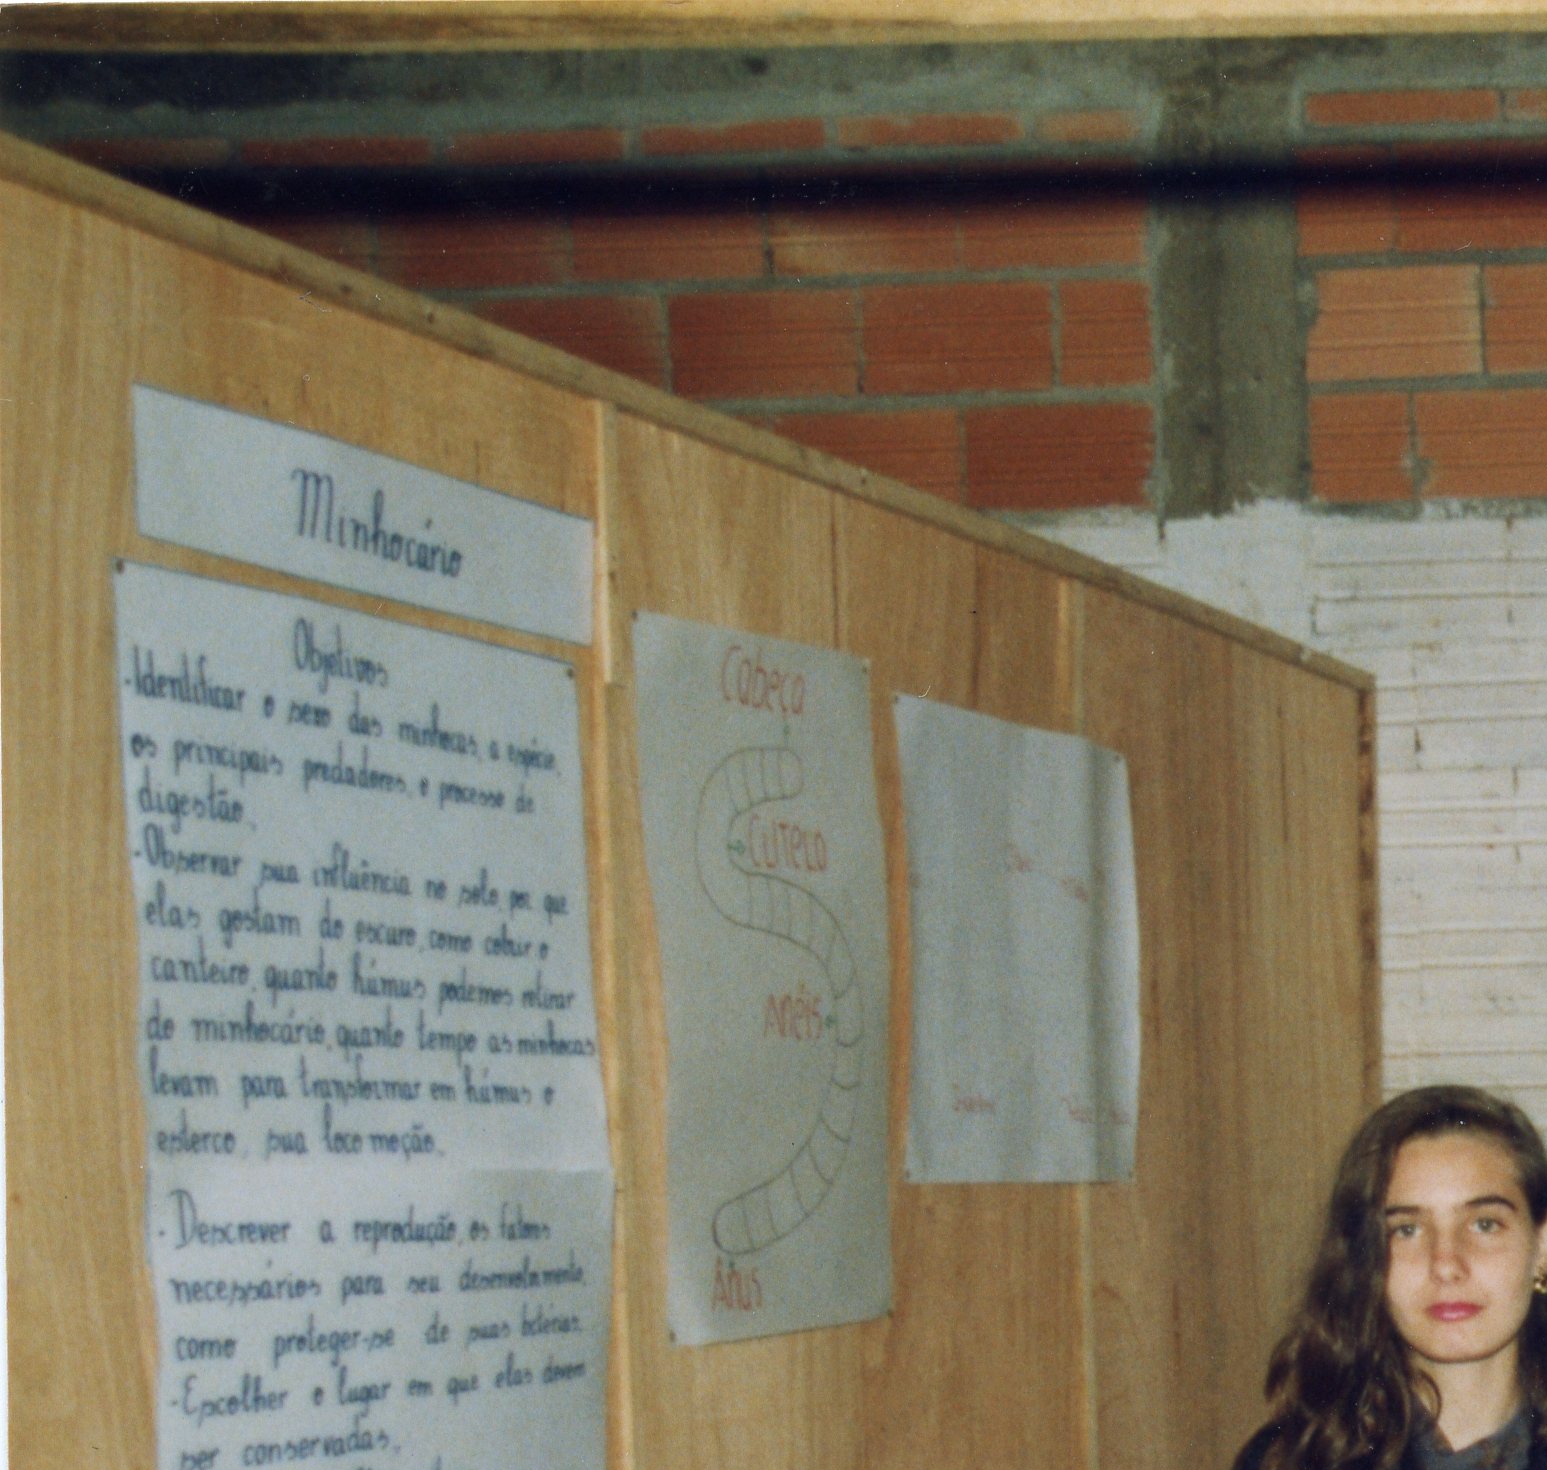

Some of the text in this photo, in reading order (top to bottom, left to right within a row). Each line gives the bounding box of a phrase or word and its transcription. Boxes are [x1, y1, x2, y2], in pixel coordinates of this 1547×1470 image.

[291, 468, 463, 577] Minhocário
[294, 617, 389, 695] Objetivos
[348, 690, 384, 738] das
[173, 739, 285, 790] principais
[312, 841, 411, 896] influência
[145, 879, 201, 930] elas
[218, 885, 302, 950] gostam
[429, 927, 473, 956] como
[264, 945, 339, 1008] quanto
[350, 949, 427, 1001] húmus
[437, 966, 514, 1016] podemos
[336, 1005, 405, 1064] quanto
[417, 1008, 478, 1068] tempo
[516, 1018, 597, 1057] minhocas
[149, 1044, 219, 1098] levam
[240, 1074, 288, 1111] para
[298, 1053, 422, 1108] transformar
[429, 1080, 457, 1102] em
[463, 1064, 533, 1106] húmus
[318, 1219, 337, 1244] a
[168, 1258, 323, 1308] necessários
[341, 1274, 386, 1306] para
[174, 1334, 238, 1363] como
[337, 1364, 393, 1419] lugar
[407, 1377, 434, 1398] em
[494, 1350, 534, 1389] elas
